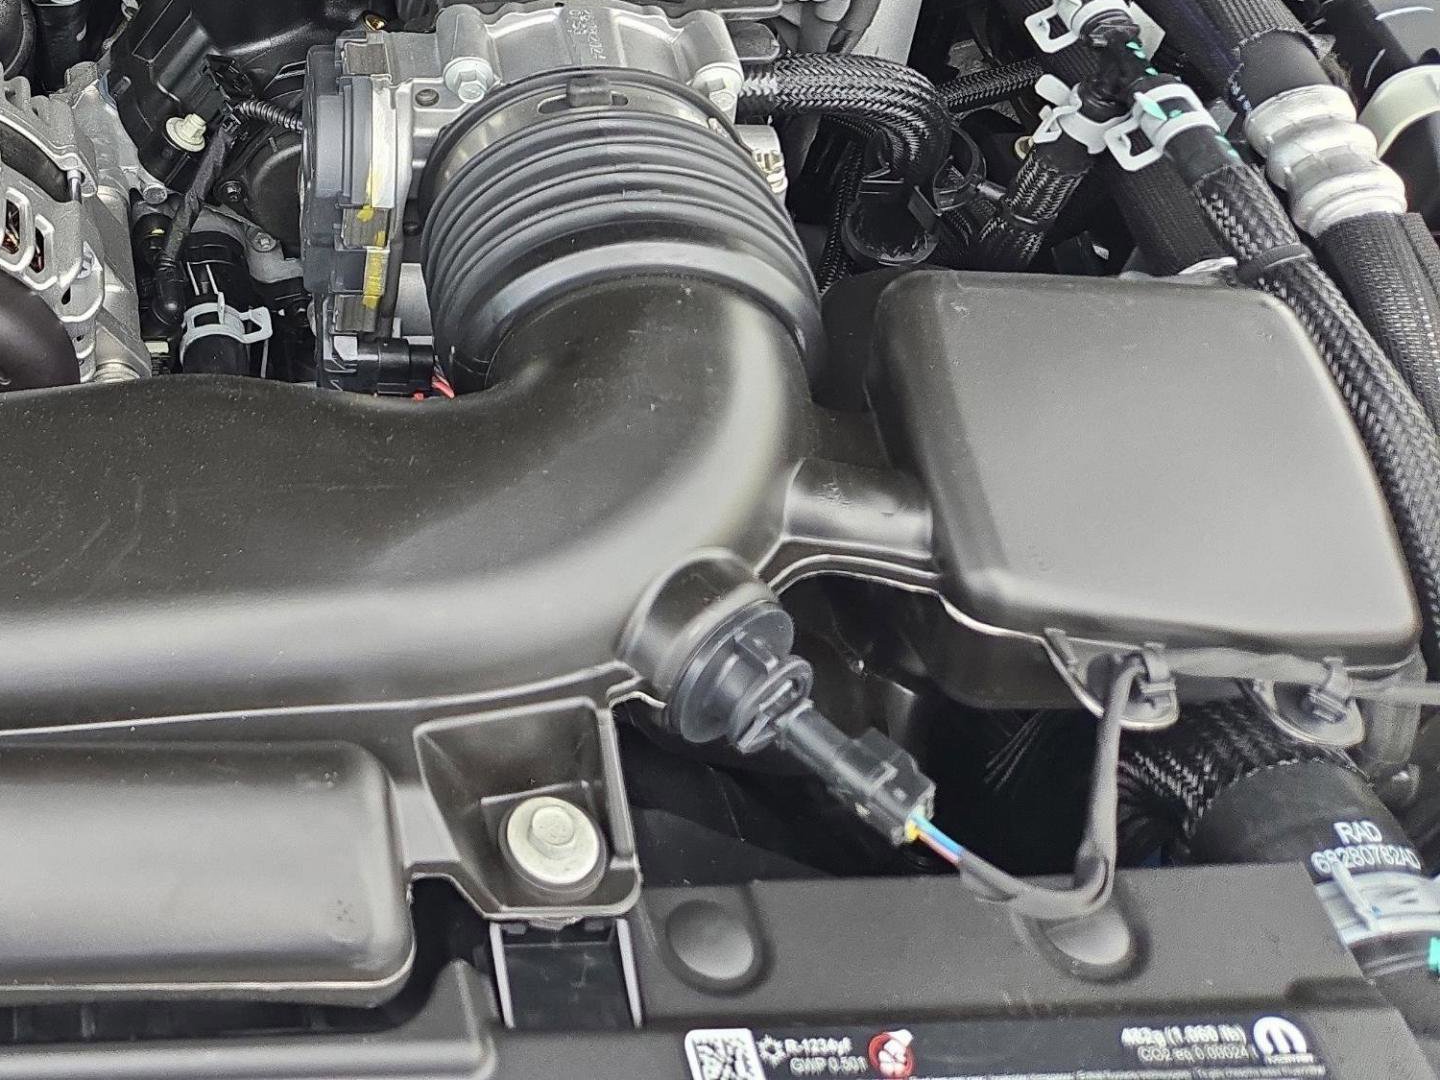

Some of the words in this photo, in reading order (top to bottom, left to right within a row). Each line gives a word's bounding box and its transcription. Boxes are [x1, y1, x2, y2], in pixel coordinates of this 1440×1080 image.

[1333, 820, 1382, 844] RAD
[1137, 1045, 1172, 1061] CO2
[790, 1057, 827, 1074] GWP
